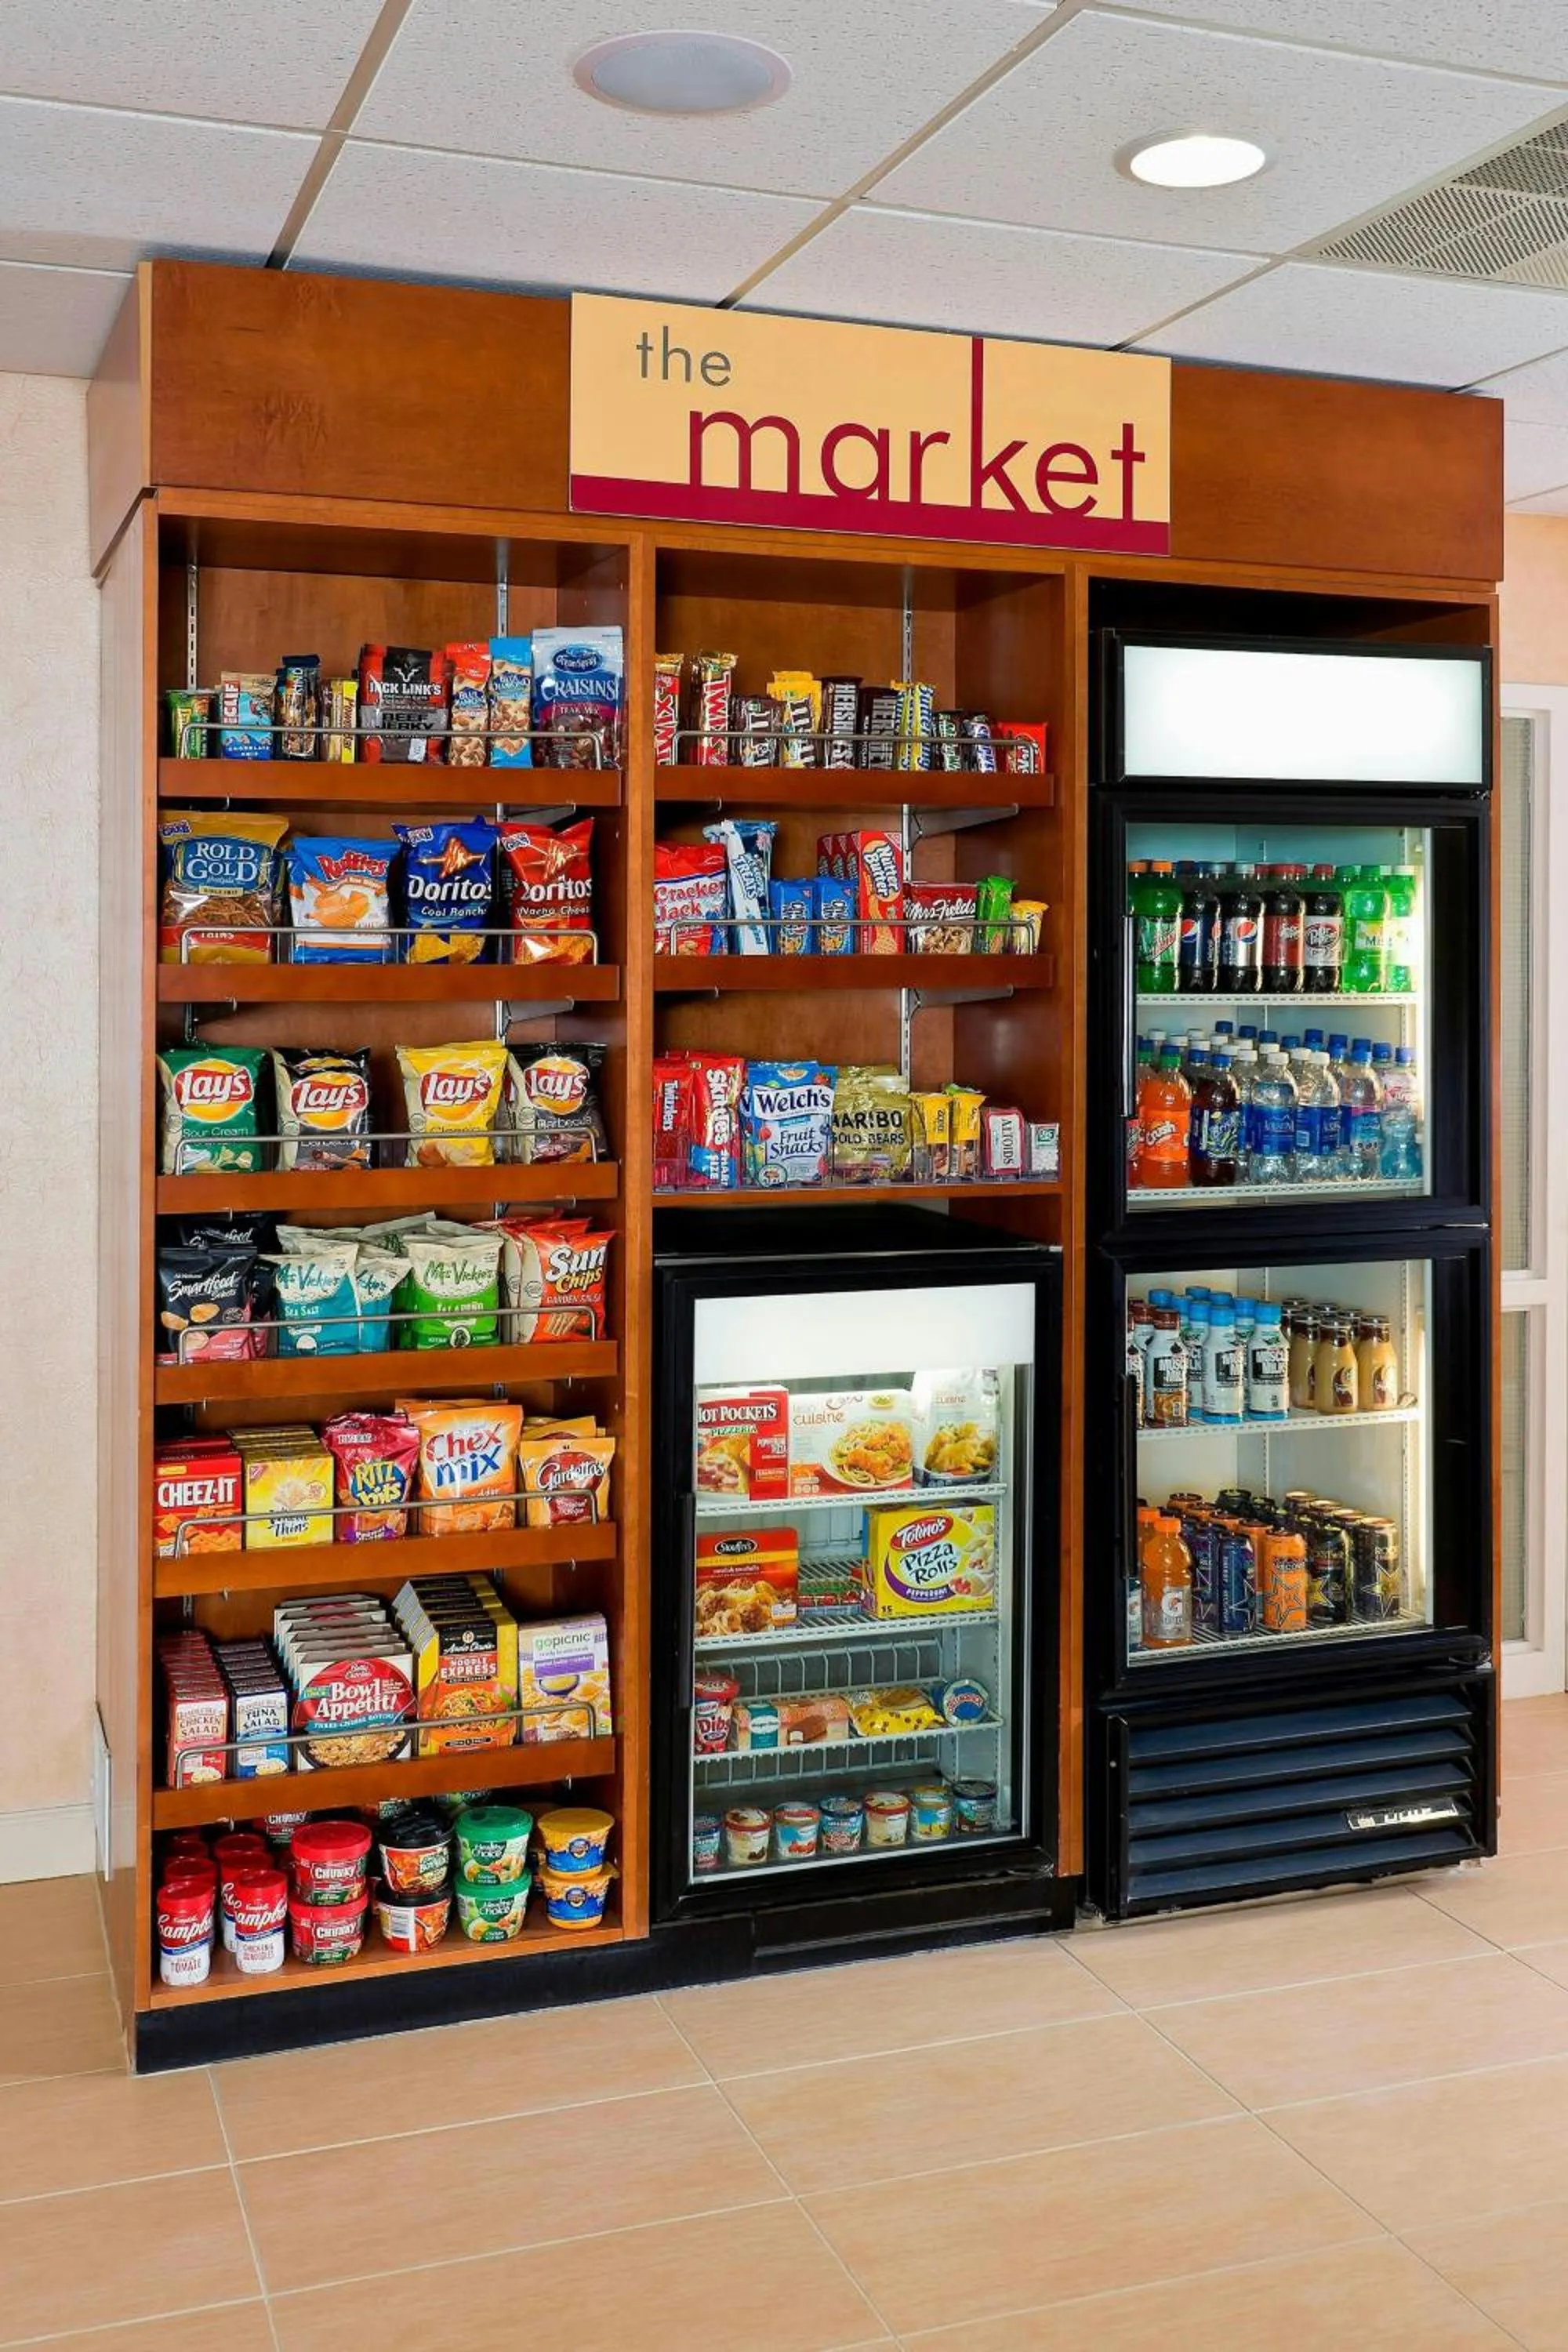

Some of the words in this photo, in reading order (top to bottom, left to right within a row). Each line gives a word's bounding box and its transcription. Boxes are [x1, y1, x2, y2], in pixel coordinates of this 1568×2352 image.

[636, 325, 731, 387] the
[689, 337, 1146, 521] market
[223, 682, 239, 717] CLIF
[403, 681, 441, 695] LINK'S
[540, 677, 616, 702] CRAISINS
[383, 712, 429, 723] BEEF
[655, 693, 679, 765] TWIX
[197, 842, 255, 861] ROLD
[186, 859, 258, 882] GOLD
[408, 874, 492, 902] Doritos
[655, 879, 727, 902] Cracker
[421, 906, 448, 916] Cool
[654, 901, 702, 924] Jack
[757, 1088, 830, 1113] Welch's
[779, 1127, 816, 1145] Fruit
[1002, 1119, 1014, 1165] ALTOIDS
[770, 1140, 823, 1159] Snacks
[545, 1246, 606, 1282] Sun
[167, 1271, 241, 1302] Smartfood
[555, 1268, 603, 1294] Chips
[285, 1305, 299, 1316] SEA
[720, 1403, 778, 1422] POCKETS
[793, 1412, 846, 1426] cuisine
[426, 1421, 503, 1463] Chex
[354, 1461, 396, 1490] RITZ
[437, 1446, 503, 1487] mix
[158, 1476, 238, 1508] CHEEZ-IT
[897, 1518, 946, 1548] Totino's
[899, 1542, 954, 1571] Pizza
[909, 1557, 958, 1584] Rolls
[535, 1632, 591, 1651] gopicnic
[440, 1663, 497, 1679] EXPRESS
[330, 1678, 383, 1702] Bowl
[244, 1718, 281, 1730] SALAD
[246, 1708, 277, 1721] TUNA
[180, 1726, 220, 1737] SALAD
